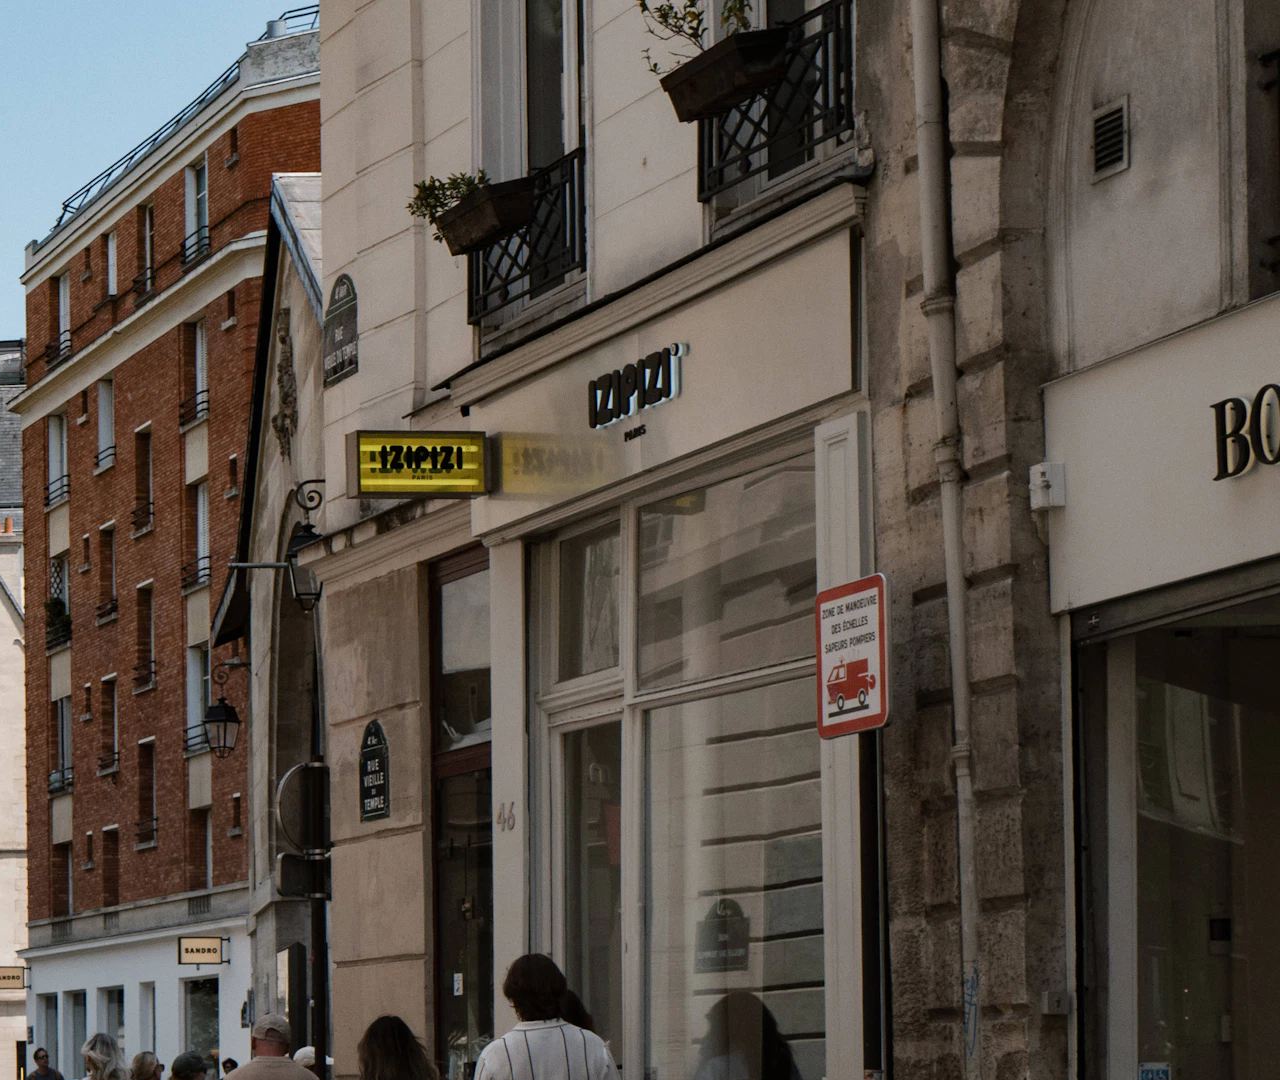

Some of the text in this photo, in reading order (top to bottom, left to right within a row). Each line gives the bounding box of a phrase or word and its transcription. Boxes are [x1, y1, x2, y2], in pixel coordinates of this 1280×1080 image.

[588, 347, 673, 429] IZIPIZI
[1209, 384, 1280, 481] BO
[380, 445, 464, 470] IZIPIZI
[822, 606, 836, 620] ZONE
[836, 604, 844, 615] DE
[831, 623, 842, 635] DES
[825, 631, 876, 654] SAPEURS POMPIERS
[367, 759, 379, 772] RUE
[363, 772, 384, 787] VIEILLE
[364, 796, 384, 811] TEMPLE
[496, 801, 516, 832] 46
